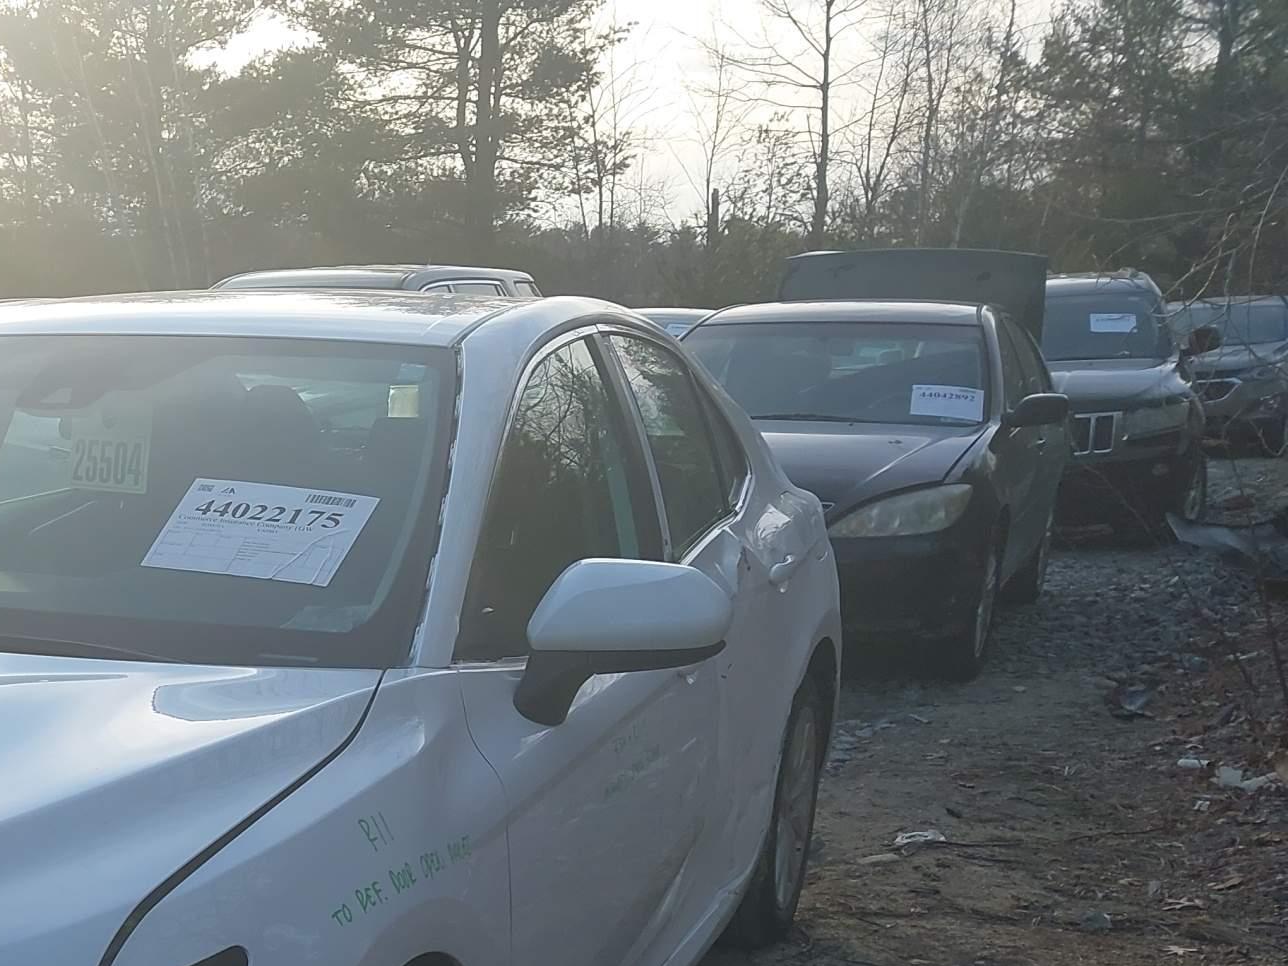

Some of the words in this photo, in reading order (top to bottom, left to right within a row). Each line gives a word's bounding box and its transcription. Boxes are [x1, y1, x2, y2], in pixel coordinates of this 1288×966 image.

[73, 440, 141, 485] 25504
[196, 500, 344, 529] 44022175
[331, 904, 353, 927] TO
